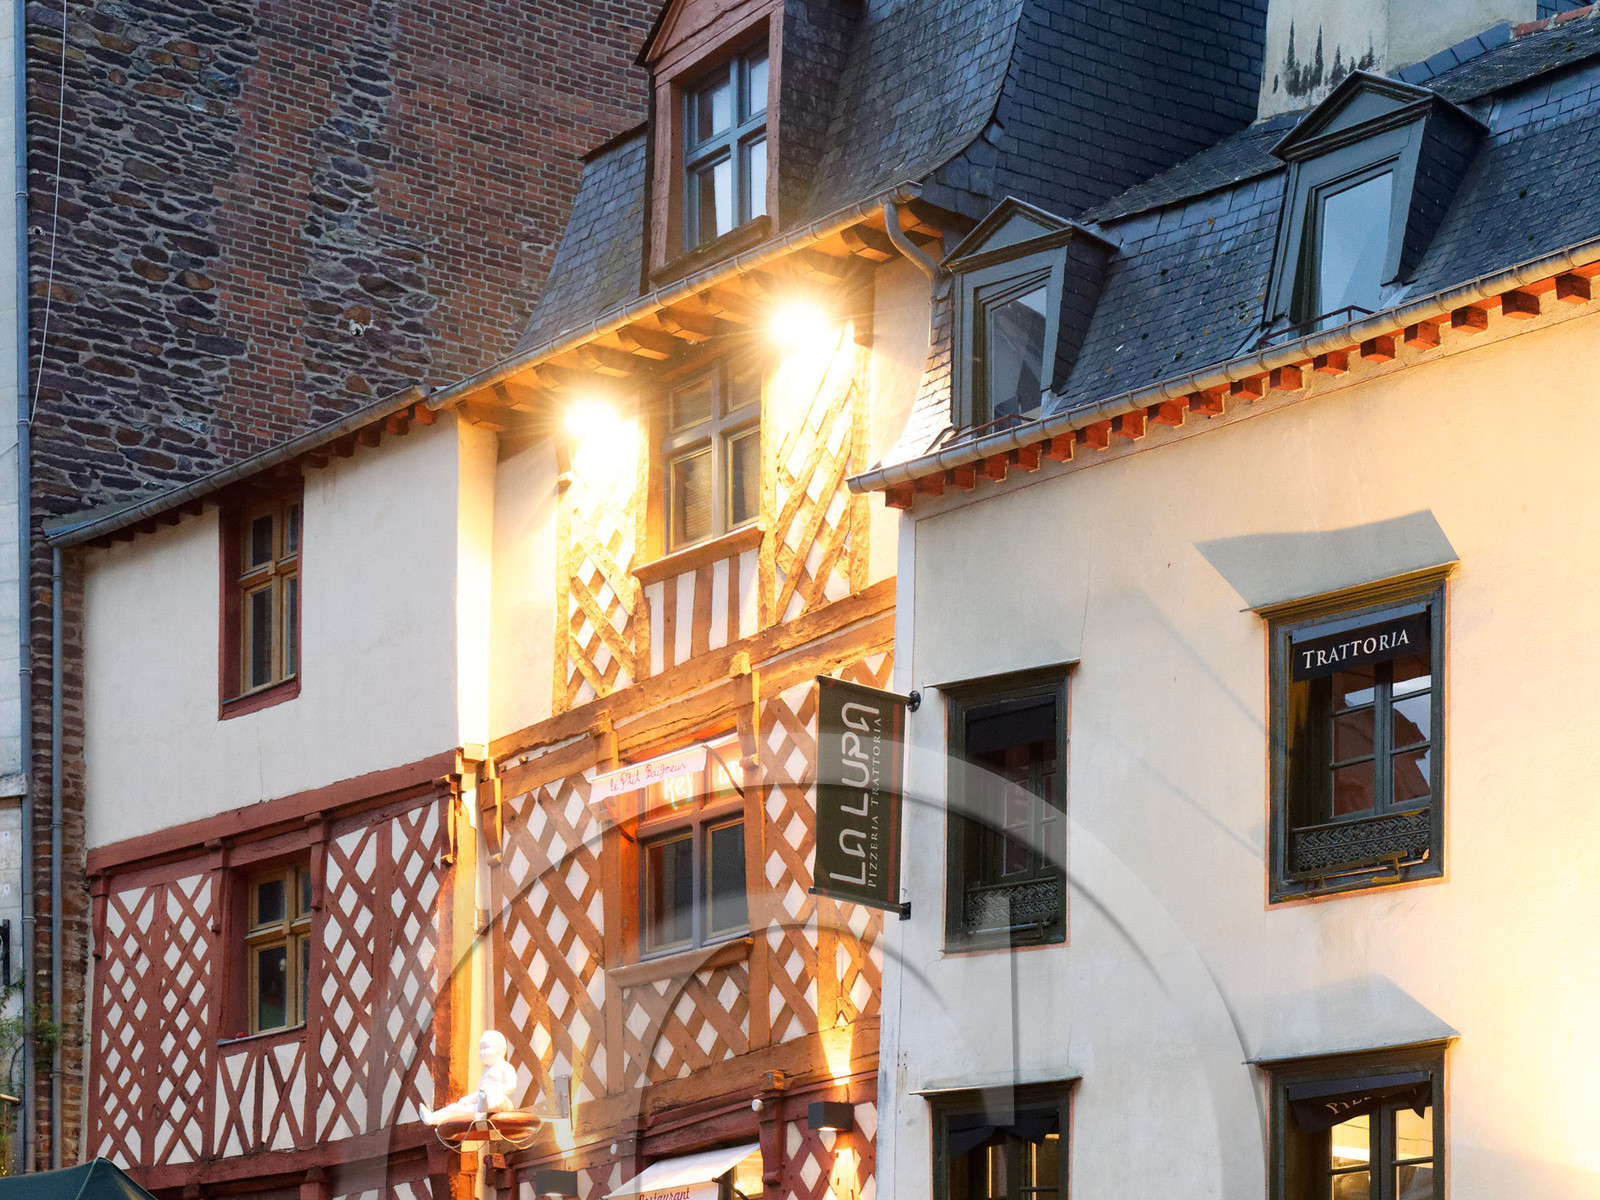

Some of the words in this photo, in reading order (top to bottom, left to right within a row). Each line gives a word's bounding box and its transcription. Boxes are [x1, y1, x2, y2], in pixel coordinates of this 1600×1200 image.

[1302, 628, 1410, 670] TRATTORIA
[645, 761, 688, 780] Baigneur
[840, 702, 880, 817] LUPA
[870, 717, 882, 807] TRATTORIA
[829, 828, 868, 886] LA
[867, 815, 879, 889] PIZZERIA
